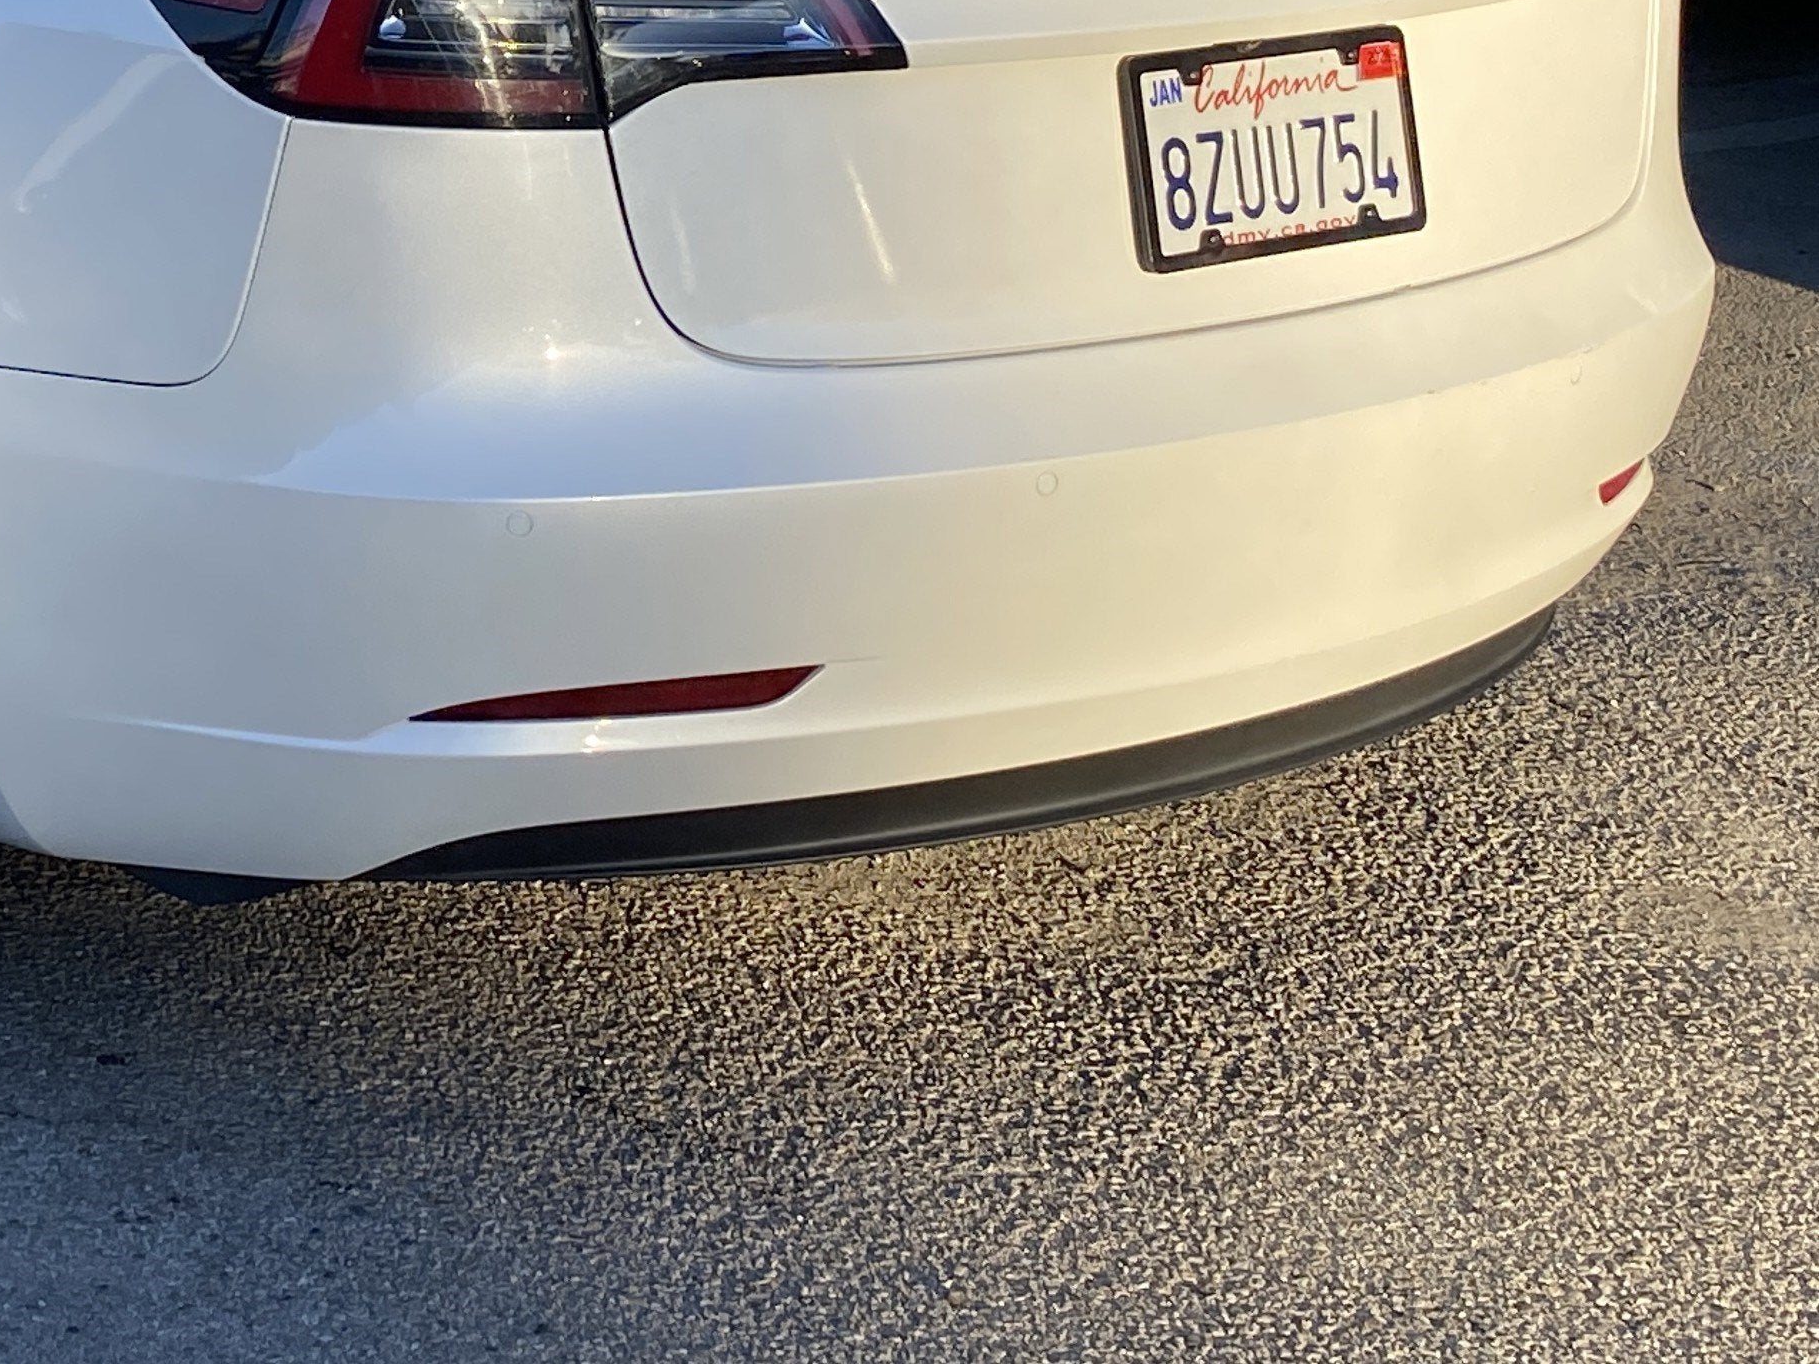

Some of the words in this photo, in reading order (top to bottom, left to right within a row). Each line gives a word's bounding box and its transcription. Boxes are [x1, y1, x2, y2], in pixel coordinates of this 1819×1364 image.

[1149, 77, 1182, 107] JAN
[1194, 61, 1358, 120] California
[1161, 109, 1398, 230] 8ZUU754
